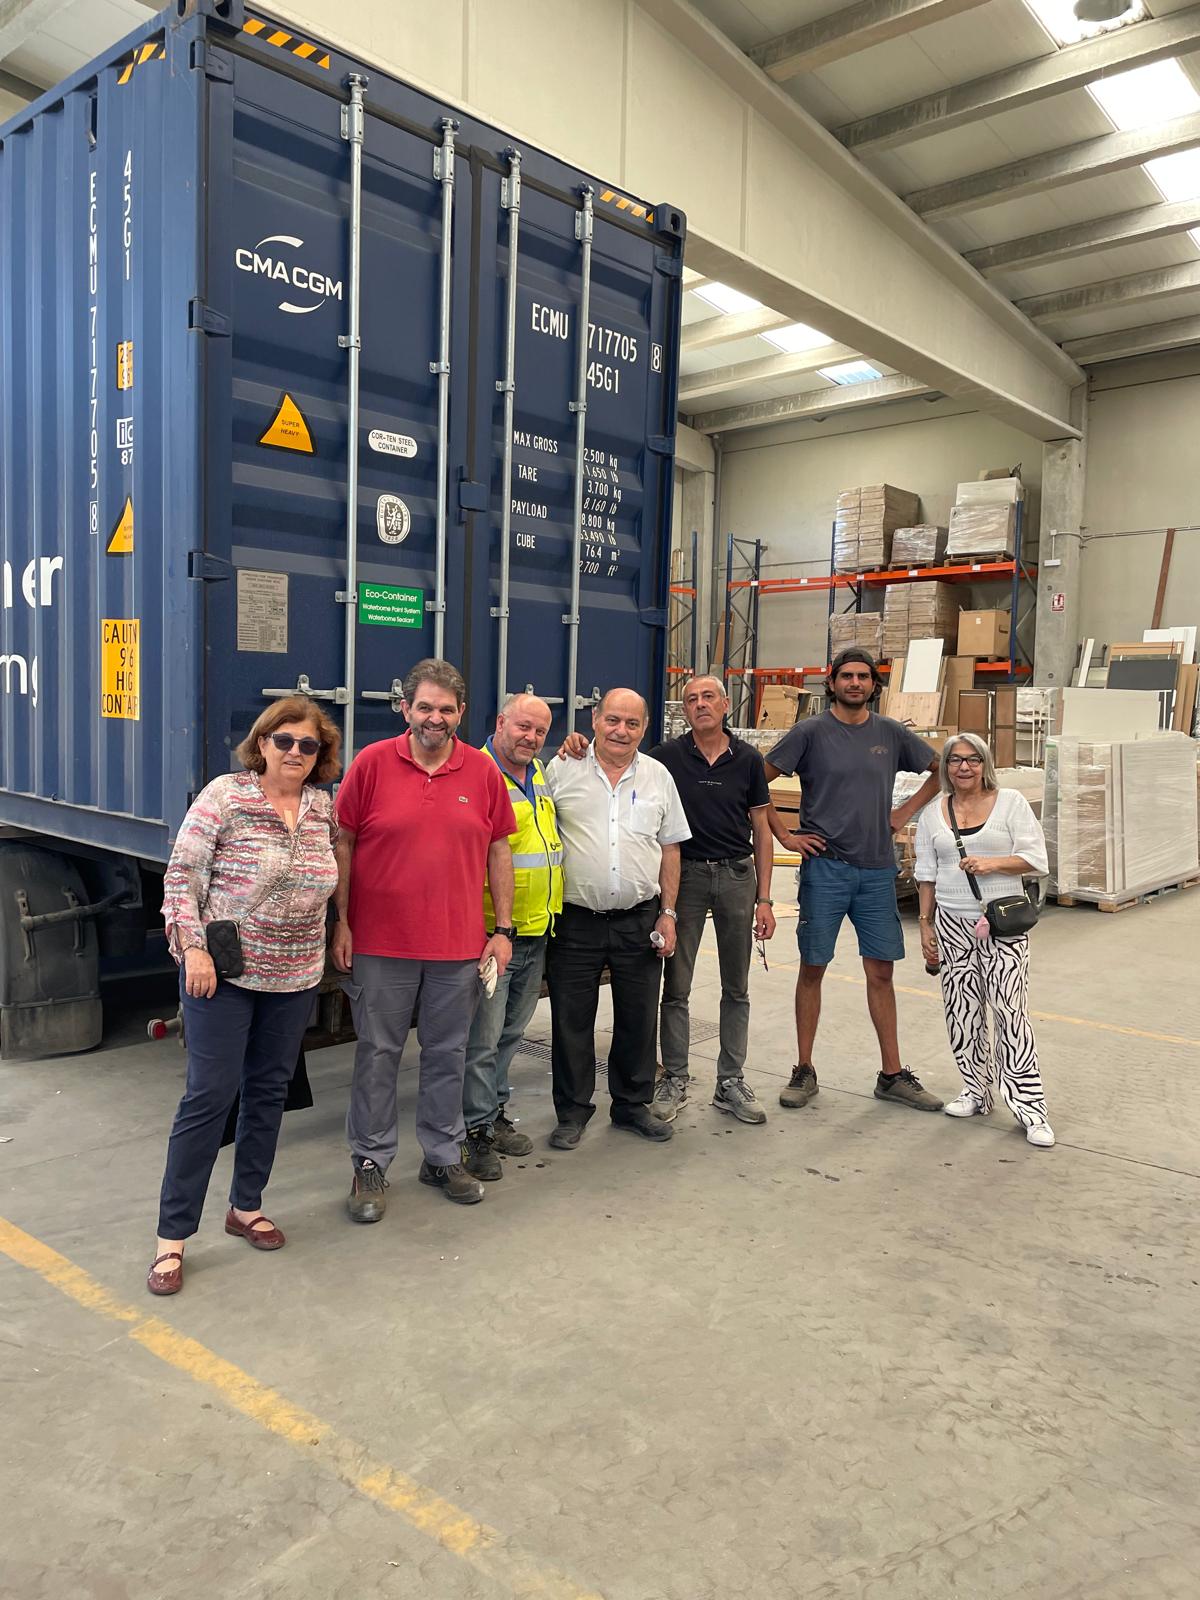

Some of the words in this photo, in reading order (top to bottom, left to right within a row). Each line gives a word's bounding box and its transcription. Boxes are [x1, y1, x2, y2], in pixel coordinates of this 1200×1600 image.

[123, 150, 132, 280] 45G1
[235, 248, 290, 284] CMA
[292, 266, 343, 300] CGM
[531, 302, 569, 340] ECMU
[588, 322, 637, 363] 717705
[652, 345, 661, 371] 8
[586, 361, 620, 394] 45G1
[90, 306, 98, 489] 717705
[280, 428, 300, 437] HEAVY
[281, 419, 300, 428] SUPER
[371, 431, 397, 443] COR-TEN
[398, 437, 414, 448] STEEL
[377, 442, 408, 454] CONTAINER
[513, 430, 531, 448] MAX
[533, 435, 558, 454] GROSS
[583, 447, 605, 465] 2.500
[609, 454, 618, 471] kg
[517, 464, 538, 482] TARE
[587, 479, 609, 497] 3.700
[613, 485, 622, 503] kg
[582, 464, 607, 480] 1.650
[511, 499, 548, 519] PAYLOAD
[581, 512, 602, 529] 8.800
[606, 517, 615, 535] kg
[516, 533, 536, 549] CUBE
[585, 544, 602, 559] 76.4
[365, 588, 418, 602] Eco-Container
[116, 671, 133, 691] HIG
